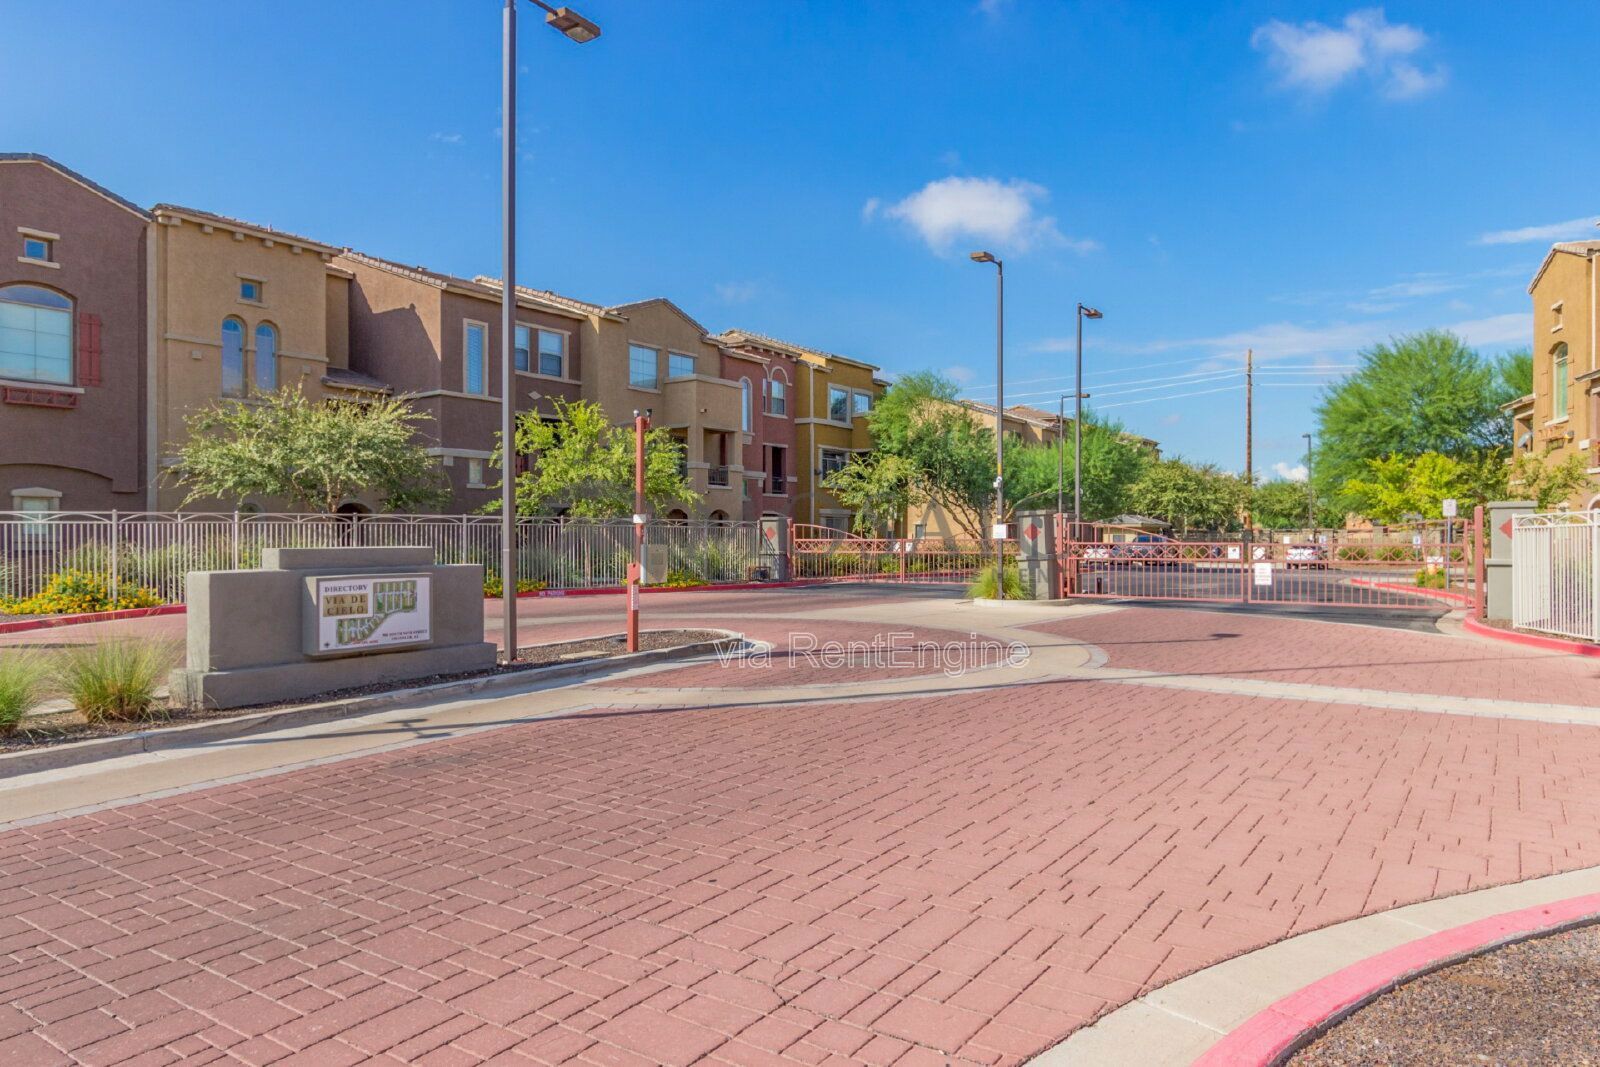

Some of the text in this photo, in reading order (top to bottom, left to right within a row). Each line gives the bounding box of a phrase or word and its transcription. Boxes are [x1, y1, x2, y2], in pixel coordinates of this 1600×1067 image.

[325, 584, 368, 593] DIRECTORY
[325, 594, 366, 604] VIA DE
[327, 605, 364, 616] CIELO
